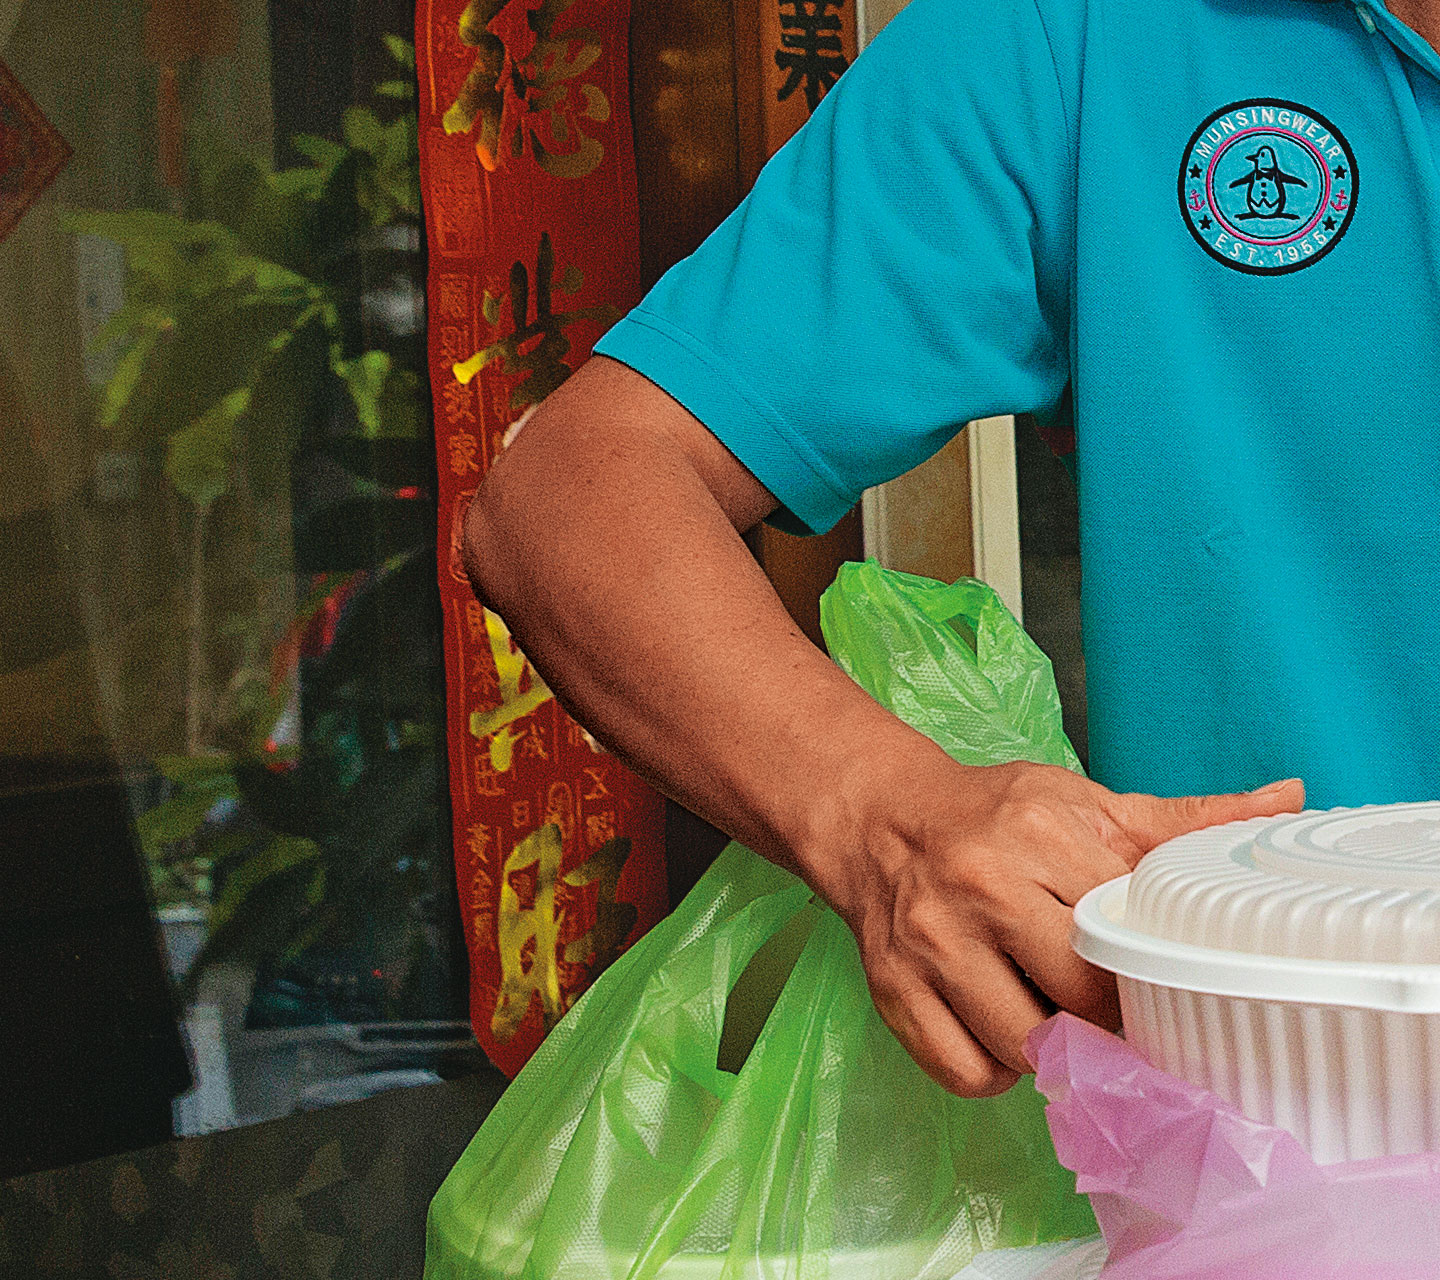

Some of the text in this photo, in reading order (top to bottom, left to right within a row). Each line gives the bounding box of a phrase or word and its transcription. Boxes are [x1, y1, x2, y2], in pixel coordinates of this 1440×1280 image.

[1194, 107, 1343, 160] MUNSINGWEAR
[1214, 229, 1328, 266] EST. 1955
